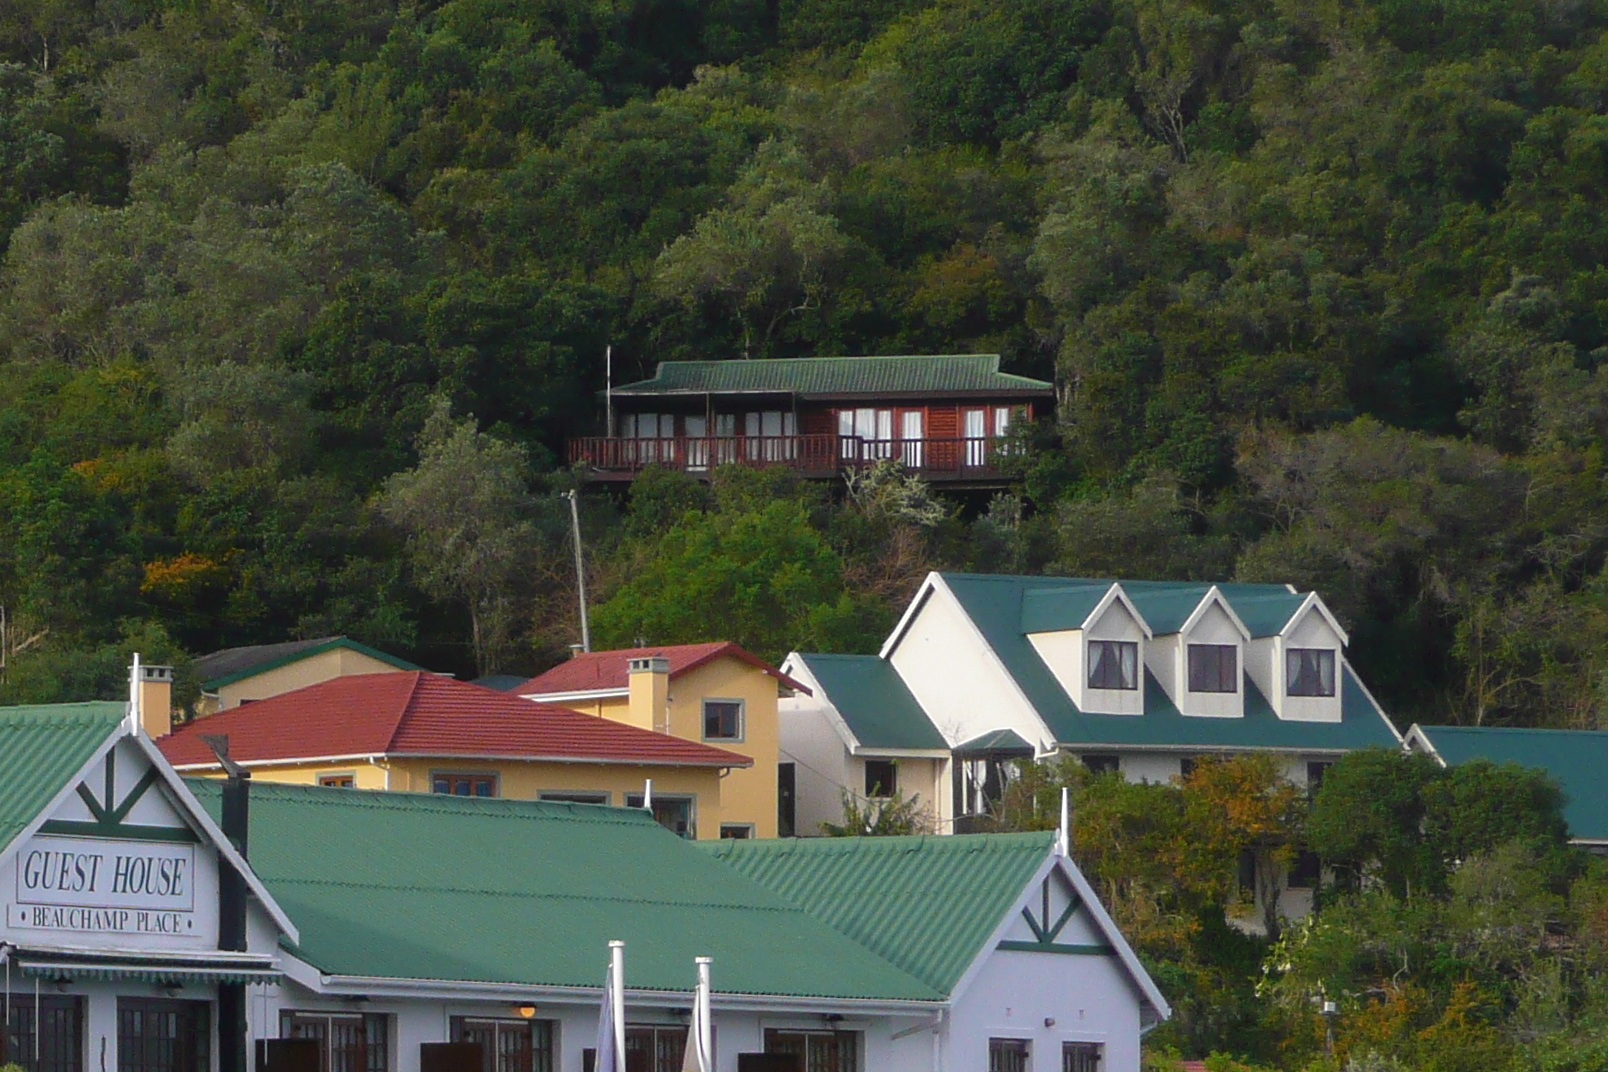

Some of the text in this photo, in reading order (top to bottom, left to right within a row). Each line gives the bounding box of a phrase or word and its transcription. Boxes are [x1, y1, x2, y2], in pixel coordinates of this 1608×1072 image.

[24, 850, 186, 896] GUEST HOUSE
[32, 907, 182, 933] BEAUCHAMP PLACE
